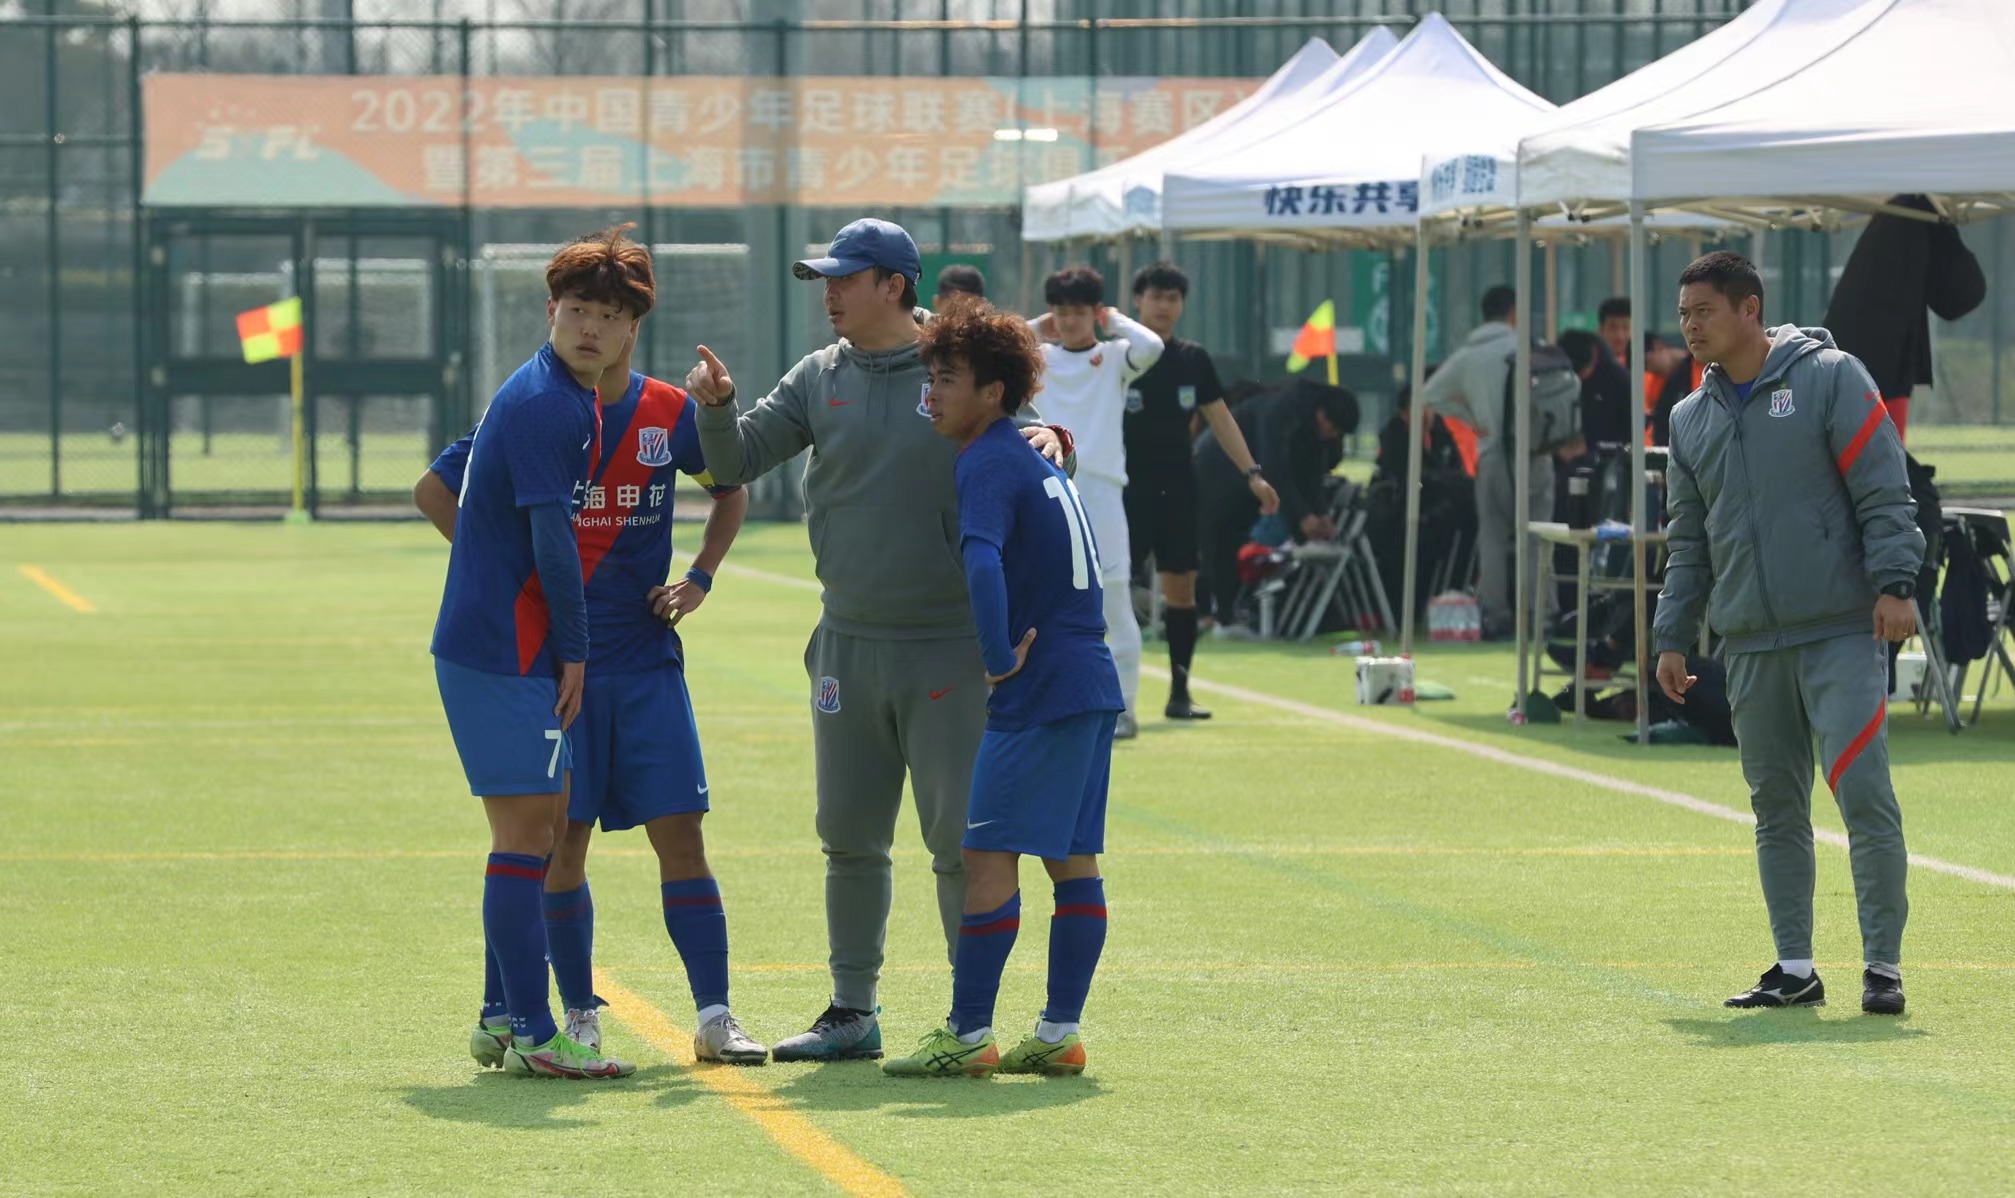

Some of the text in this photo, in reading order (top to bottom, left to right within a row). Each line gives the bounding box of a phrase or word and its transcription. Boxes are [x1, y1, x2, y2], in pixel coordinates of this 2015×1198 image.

[351, 87, 1250, 135] 2022年中国青少年足球联赛(上海赛区
[194, 123, 320, 161] SFL
[572, 480, 666, 509] 上海申花
[545, 730, 562, 778] 7
